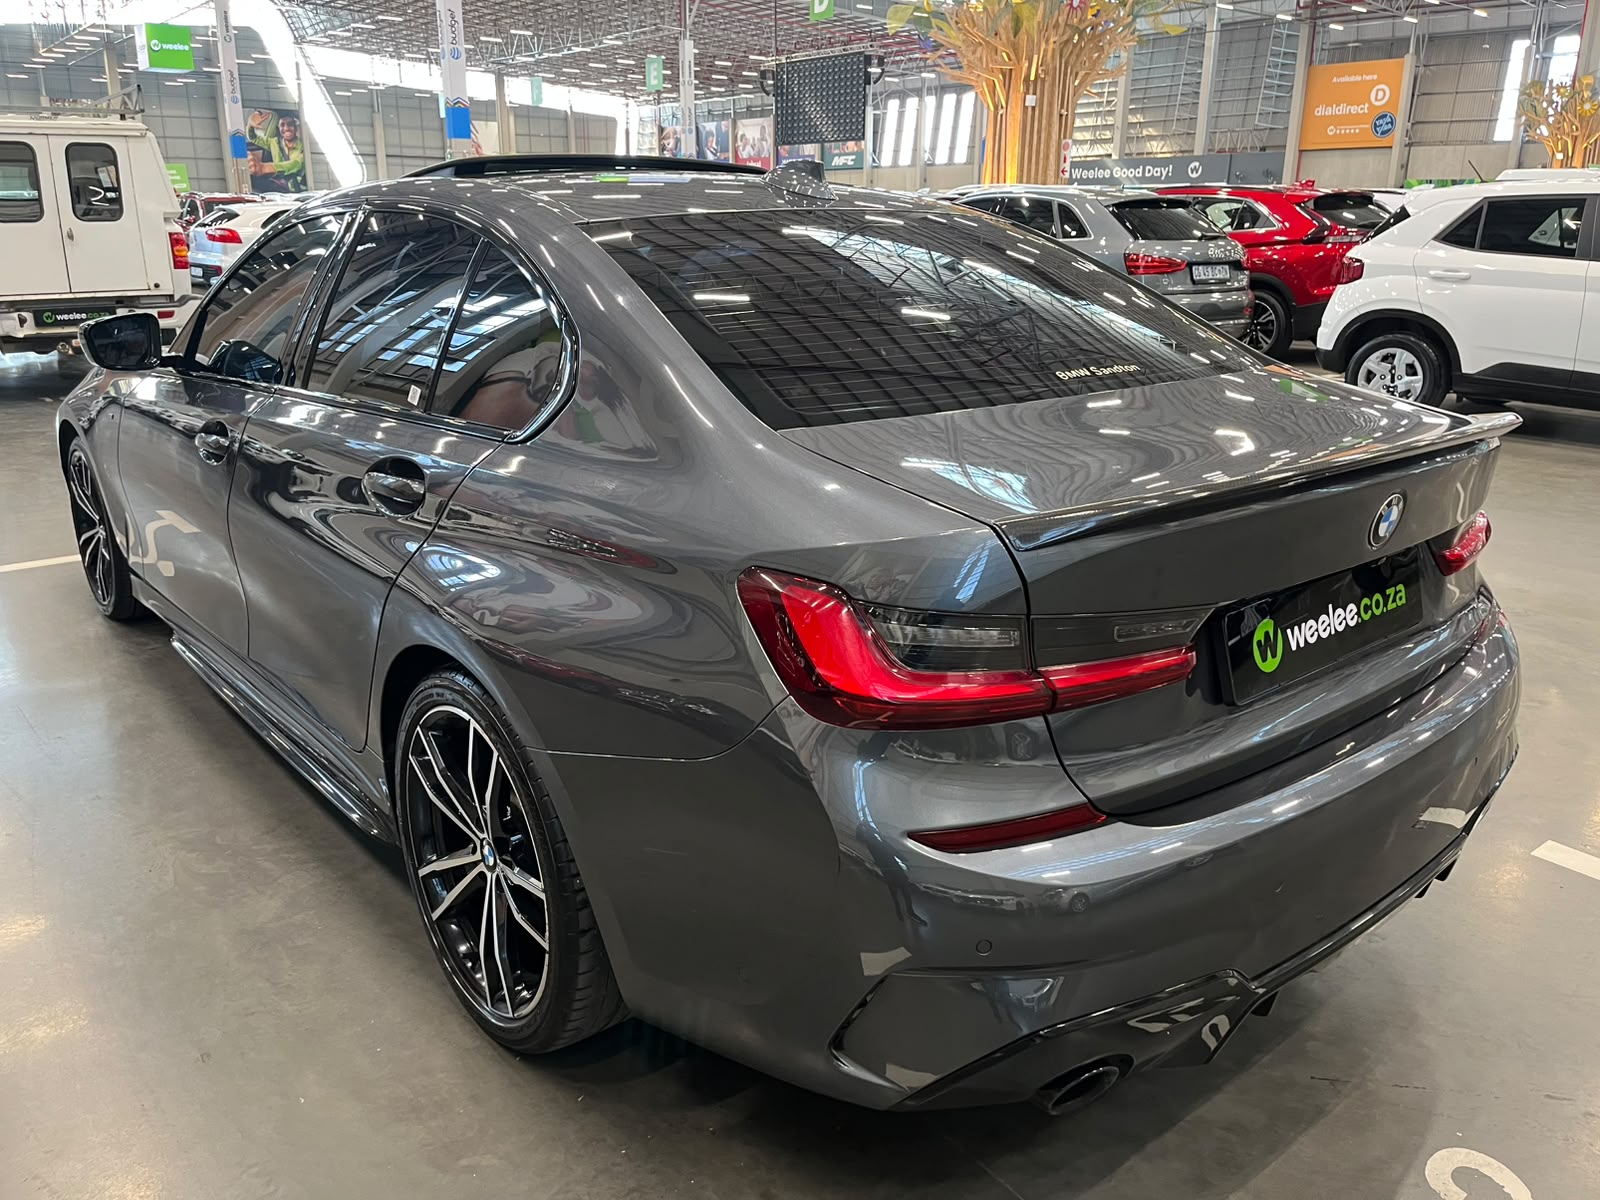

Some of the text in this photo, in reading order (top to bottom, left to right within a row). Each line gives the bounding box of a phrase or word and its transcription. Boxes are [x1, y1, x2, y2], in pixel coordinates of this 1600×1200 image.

[448, 9, 459, 45] budget
[161, 43, 190, 51] weelee
[650, 62, 659, 85] E
[1332, 75, 1362, 83] Available
[1314, 103, 1369, 117] dialdirect
[831, 155, 856, 166] MFC
[1071, 167, 1111, 179] Weelee
[1113, 166, 1142, 178] Good
[1145, 164, 1173, 180] Day!
[1055, 364, 1141, 380] BMW Sandton
[1286, 583, 1407, 652] weelee.co.za
